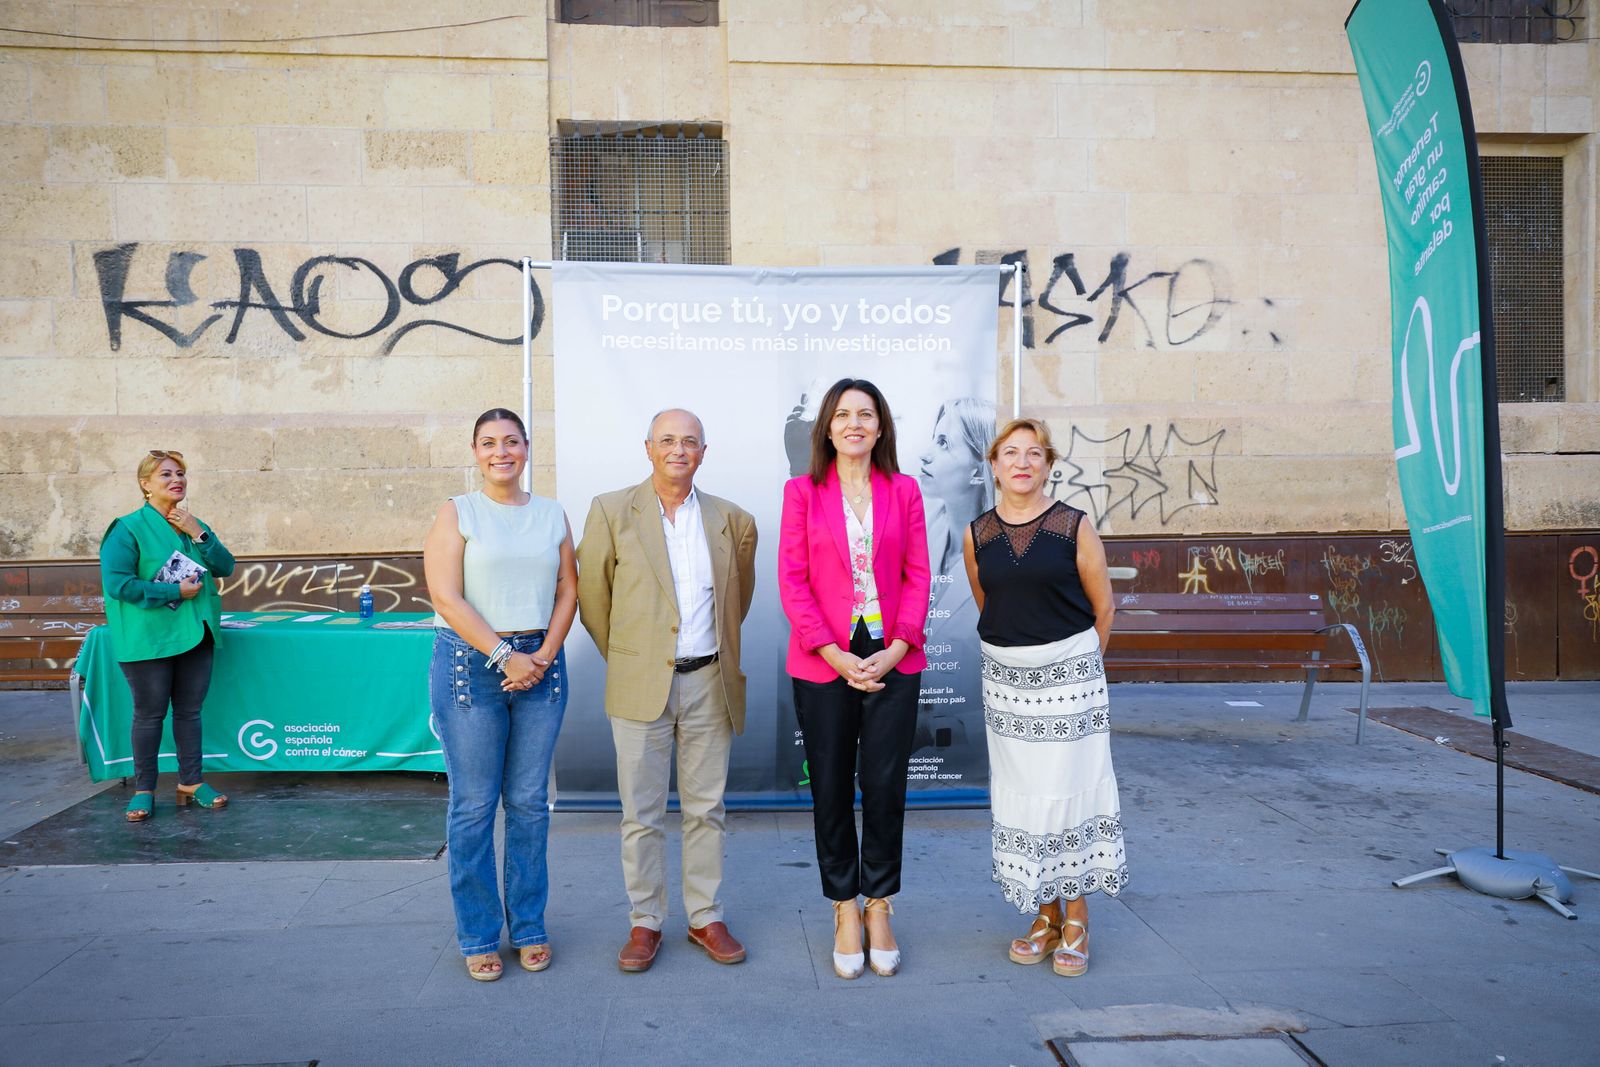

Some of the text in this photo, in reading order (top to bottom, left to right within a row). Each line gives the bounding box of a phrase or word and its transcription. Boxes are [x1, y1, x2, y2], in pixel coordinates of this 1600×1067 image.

[601, 294, 952, 331] Porque tú, yo y todos
[601, 331, 951, 356] necesitamos más investigación
[923, 642, 952, 656] tegia
[922, 660, 961, 671] áncer.
[945, 686, 954, 694] la
[949, 695, 966, 705] país
[284, 722, 340, 733] asociación
[284, 734, 333, 746] española
[285, 746, 368, 758] contra el cáncer
[929, 772, 937, 780] el
